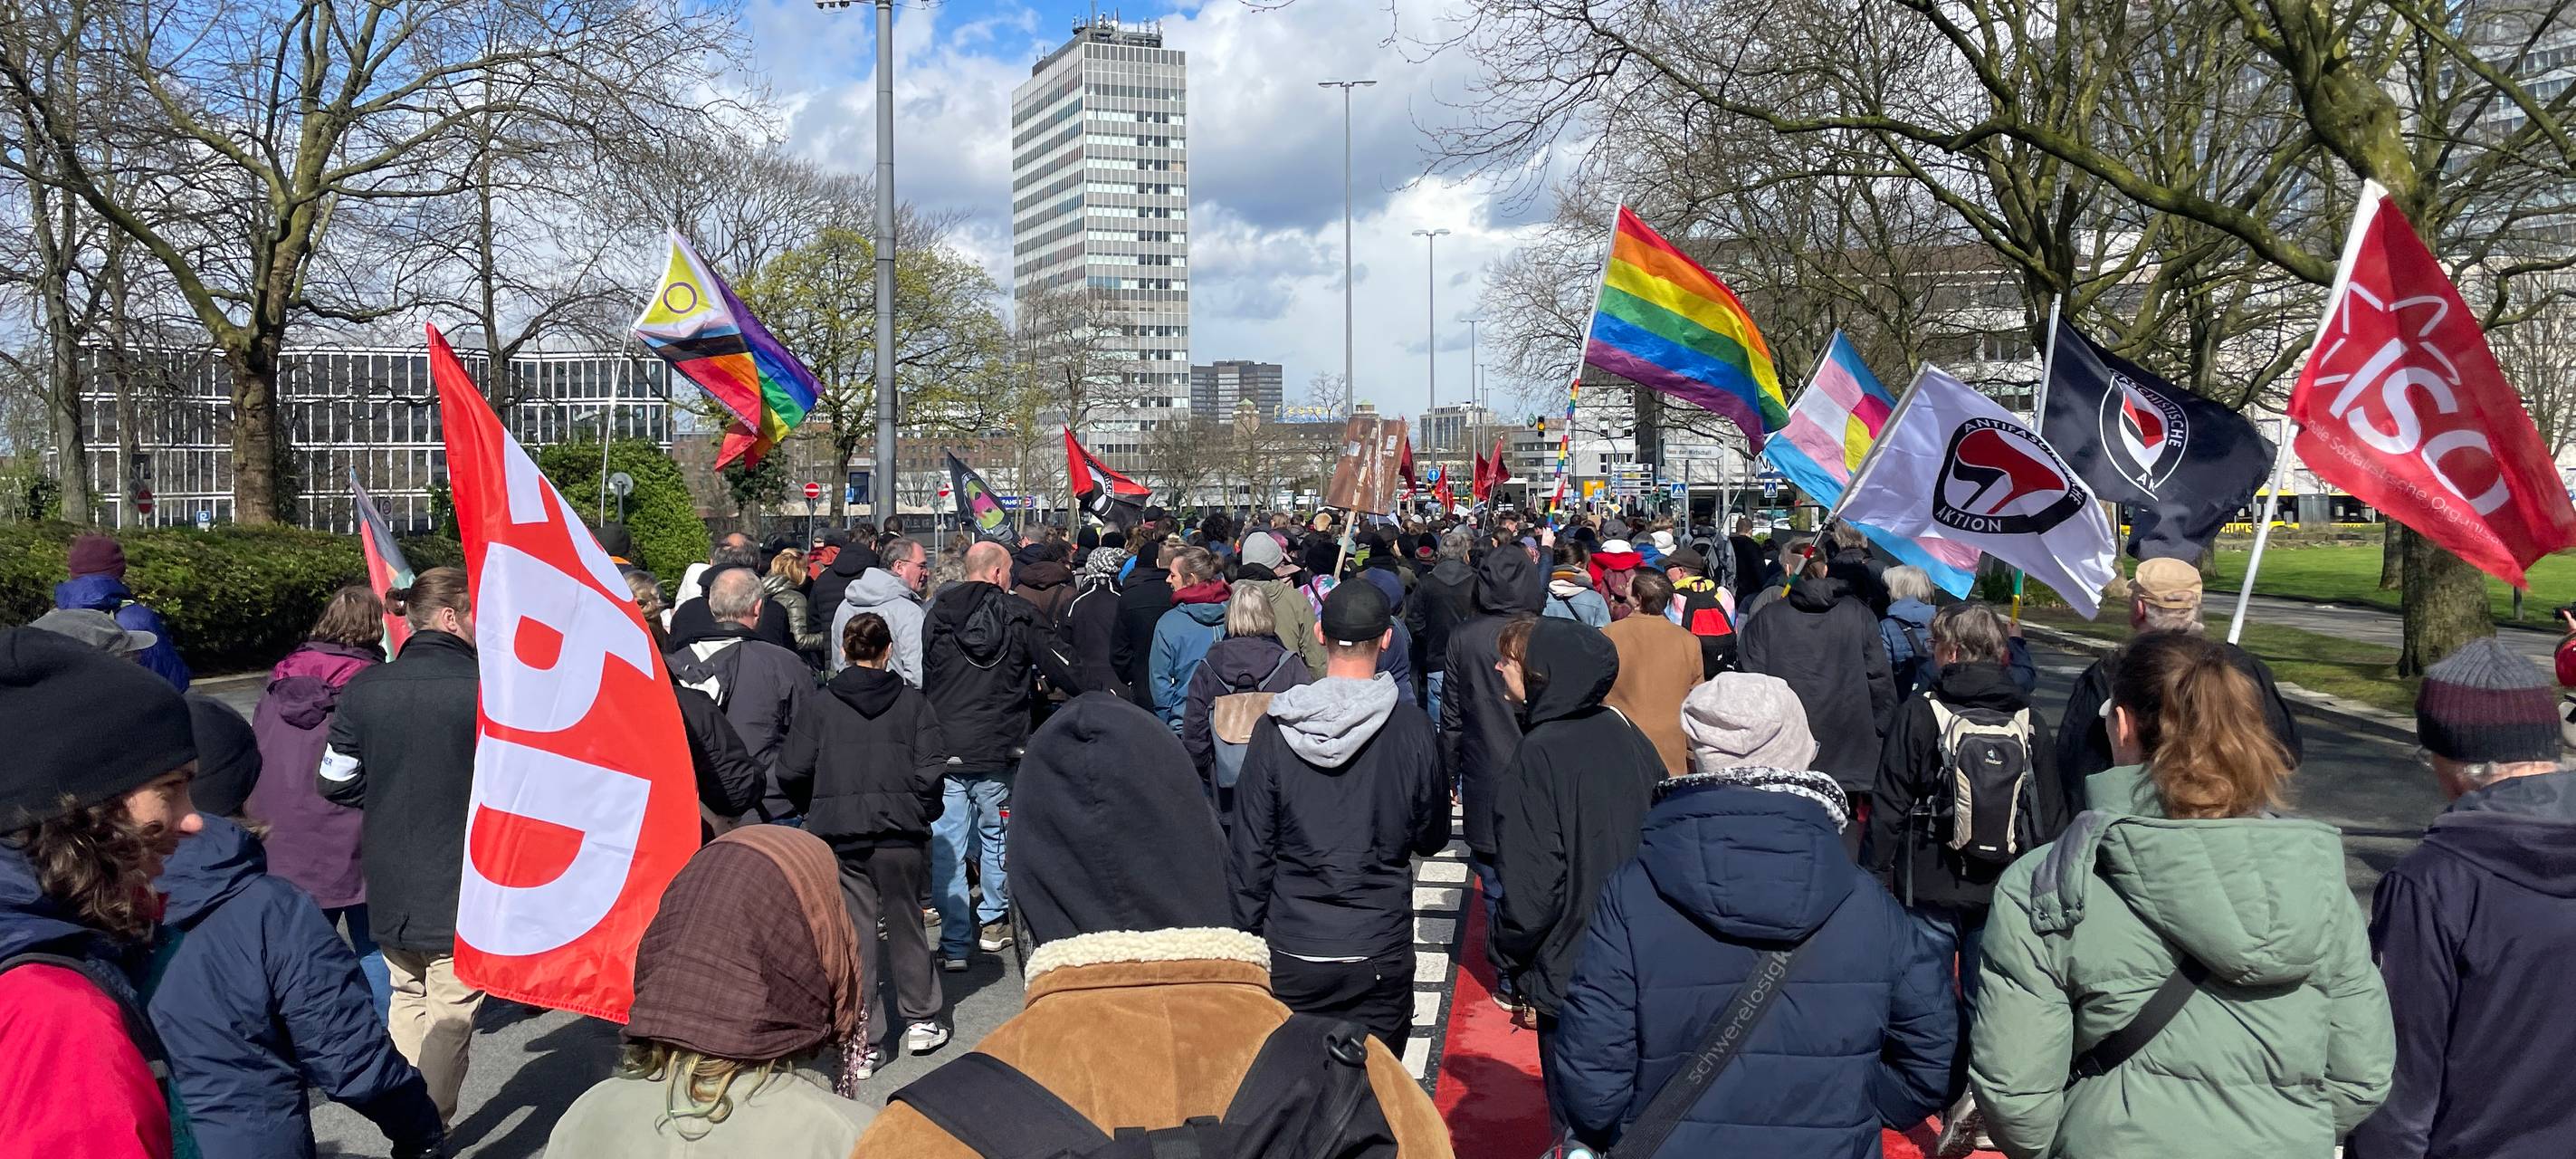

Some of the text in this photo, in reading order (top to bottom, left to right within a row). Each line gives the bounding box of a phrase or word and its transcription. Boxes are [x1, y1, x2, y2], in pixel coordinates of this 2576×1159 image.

[2330, 338, 2510, 516] ISO
[2330, 436, 2428, 500] Sozialistische
[1935, 505, 2001, 532] AKTION
